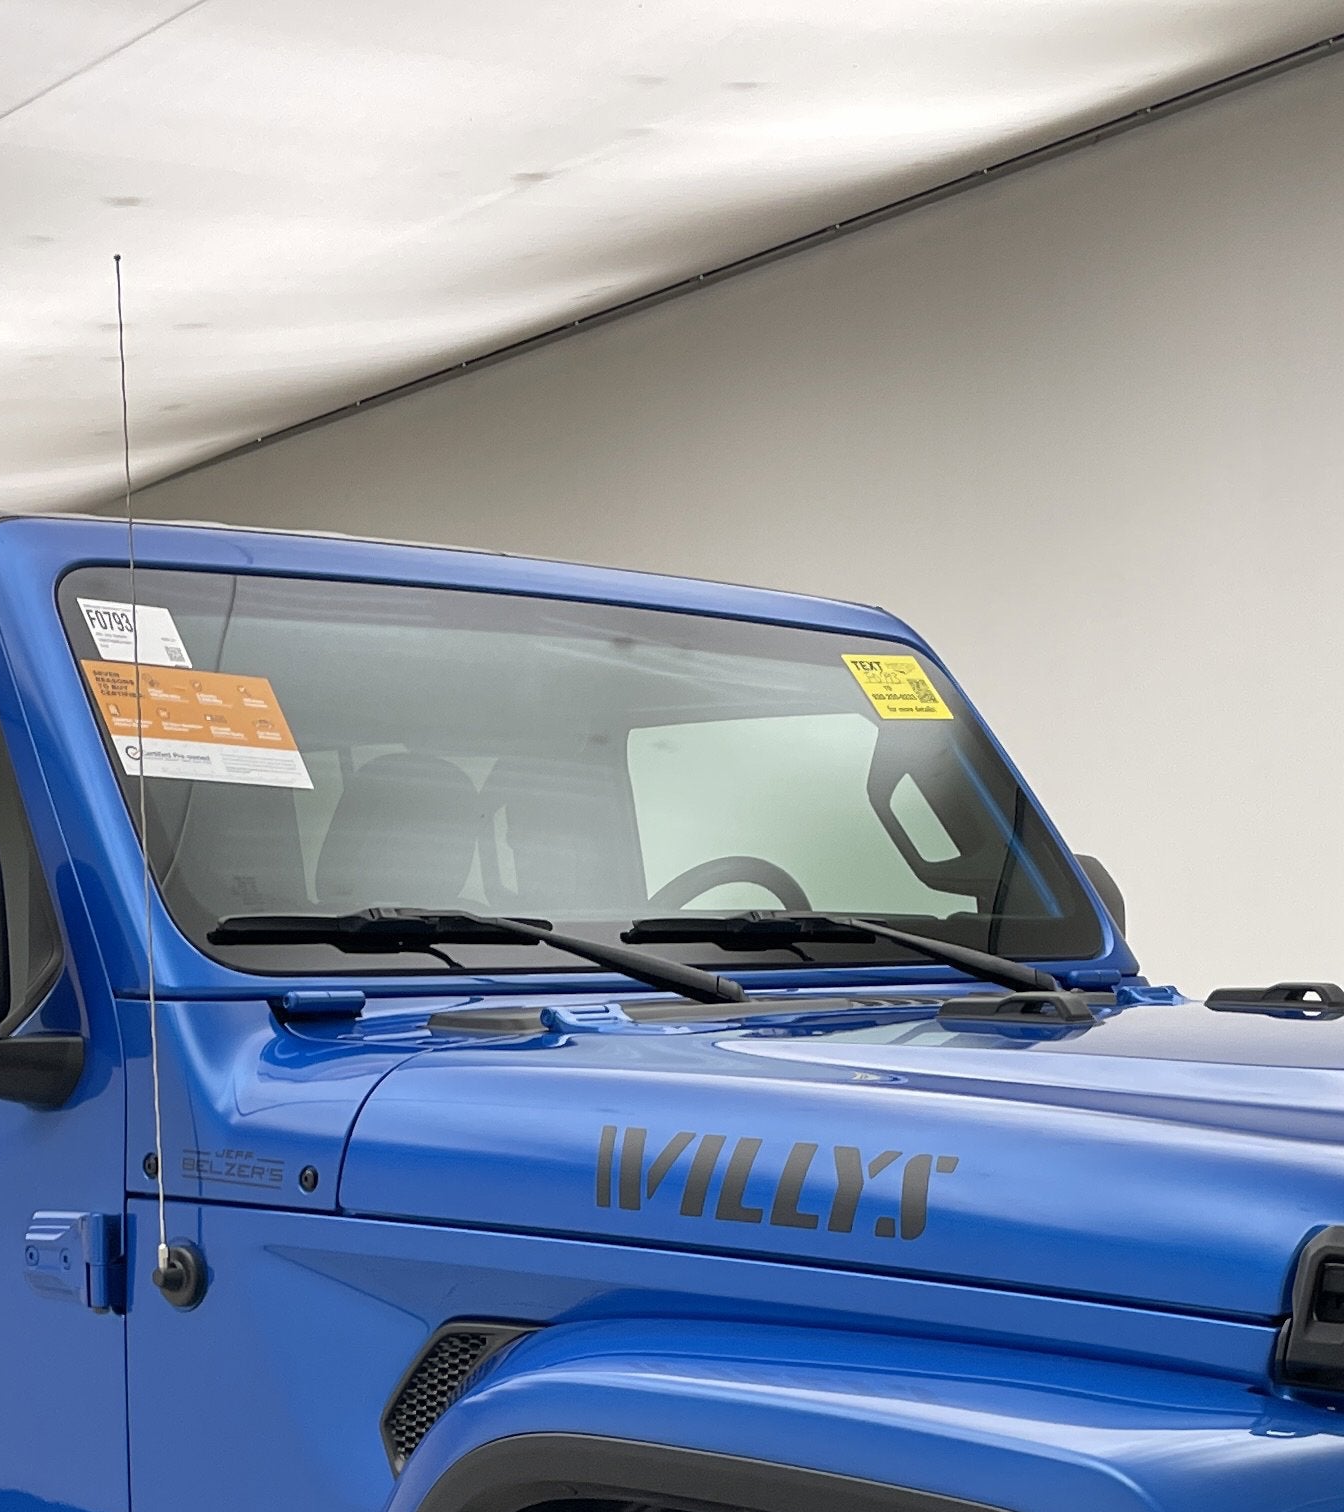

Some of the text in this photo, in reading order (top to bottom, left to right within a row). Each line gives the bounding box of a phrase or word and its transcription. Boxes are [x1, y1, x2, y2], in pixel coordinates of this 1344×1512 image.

[86, 608, 134, 633] F0793
[851, 660, 883, 673] TEXT
[215, 1148, 255, 1159] JEFF
[182, 1157, 283, 1182] BELZER'S
[596, 1125, 959, 1241] WILLYS
